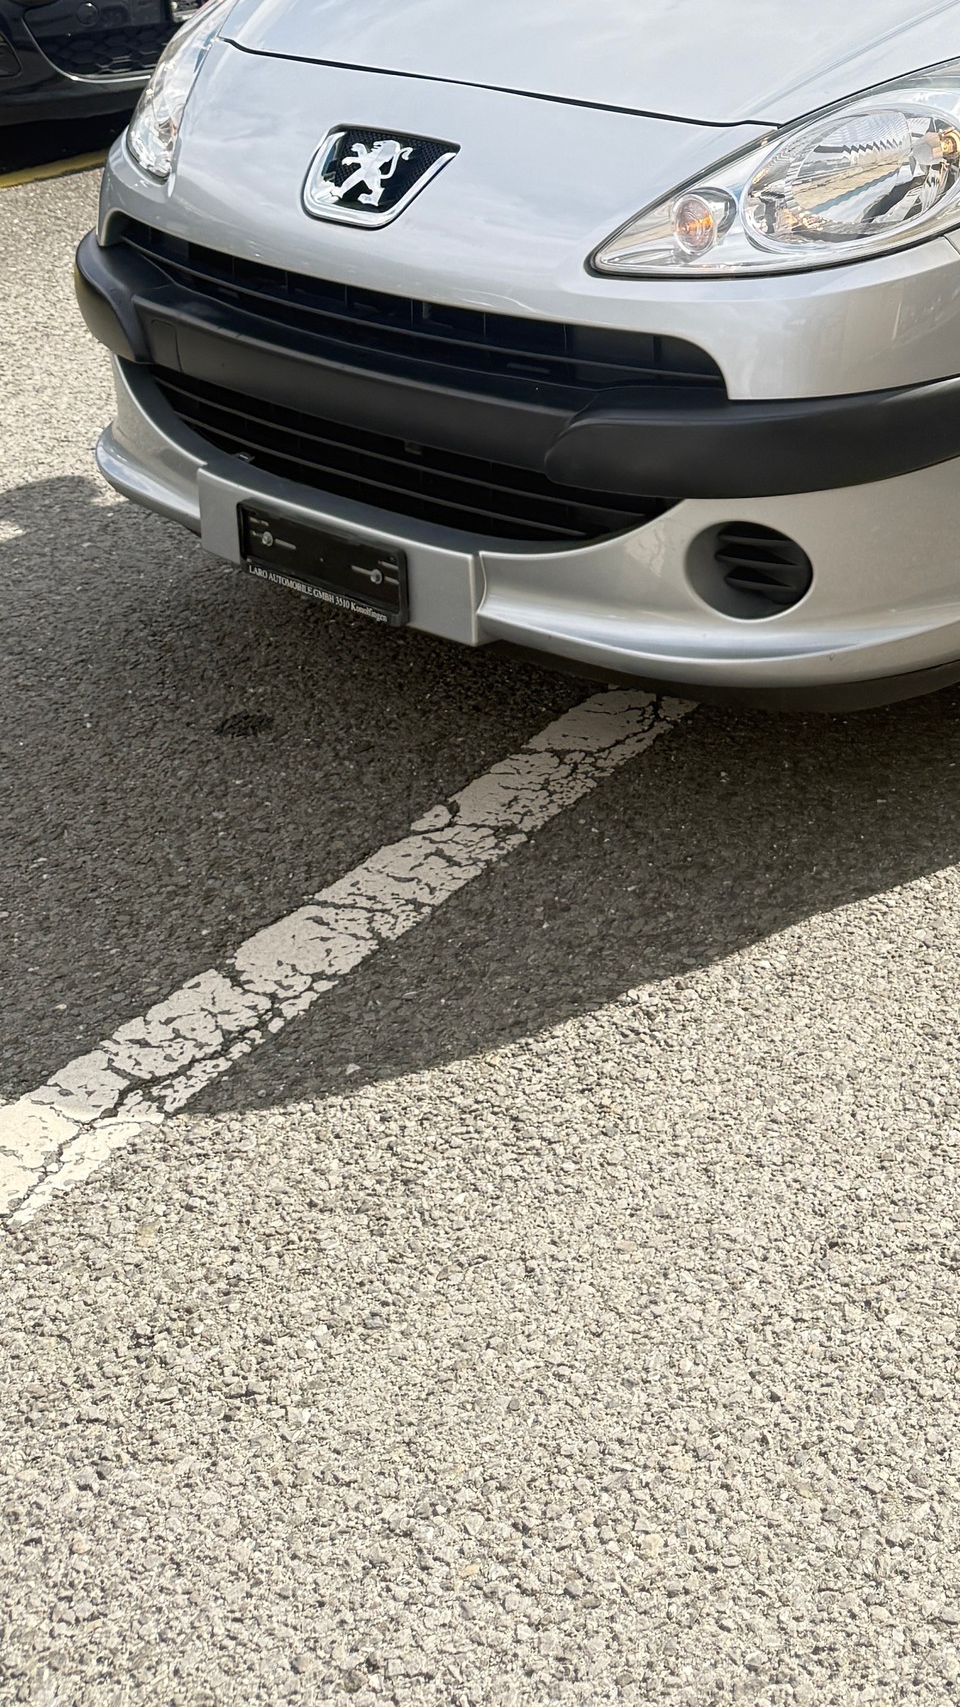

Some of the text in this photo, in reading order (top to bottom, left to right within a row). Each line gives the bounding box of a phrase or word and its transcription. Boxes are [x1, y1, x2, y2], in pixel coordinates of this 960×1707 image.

[248, 564, 268, 579] LARO
[268, 572, 313, 596] AUTOMOBILE
[313, 588, 335, 604] GMBH
[335, 596, 351, 610] 3510
